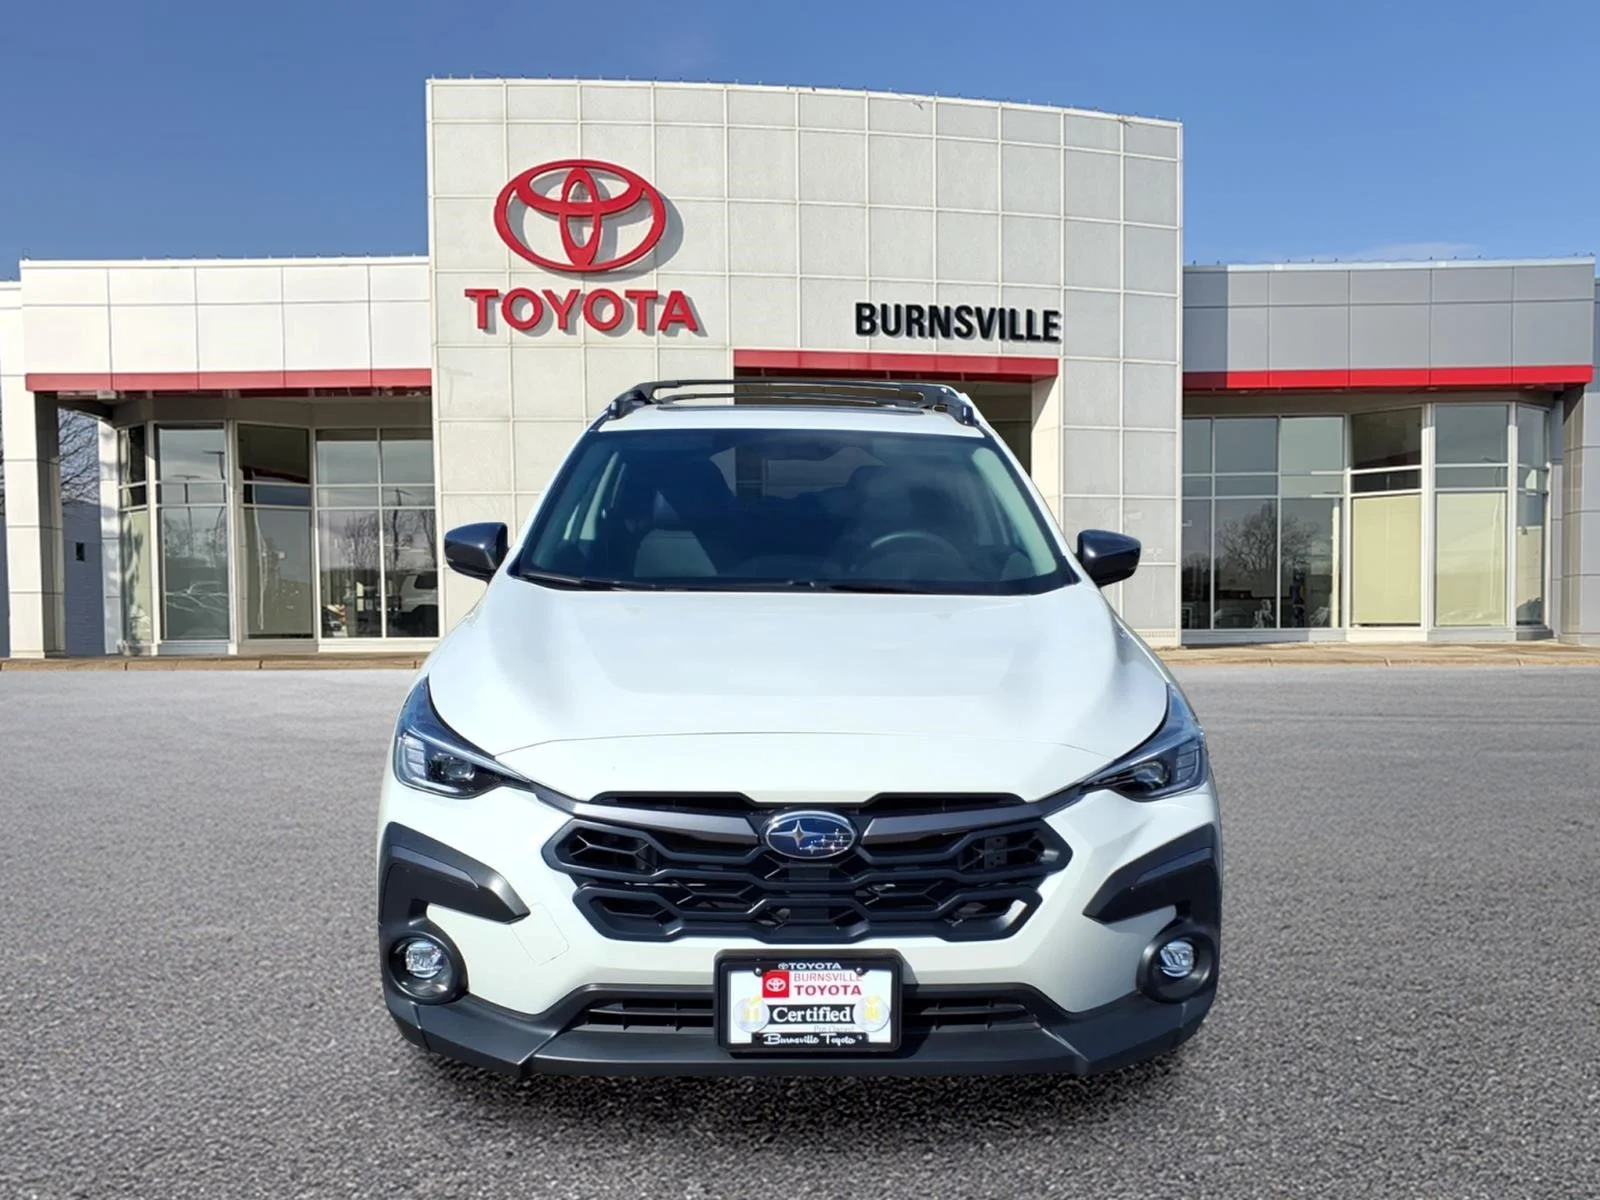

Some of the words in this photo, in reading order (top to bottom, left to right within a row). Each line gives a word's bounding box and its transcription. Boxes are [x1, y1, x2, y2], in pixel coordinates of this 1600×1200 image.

[464, 288, 699, 331] TOYOTA
[856, 302, 1062, 342] BURNSVILLE
[788, 962, 841, 970] TOYOTA
[794, 985, 862, 996] TOYOTA
[772, 1006, 850, 1022] Certified
[762, 1033, 819, 1045] Burnsville
[820, 1033, 856, 1046] Toyota
